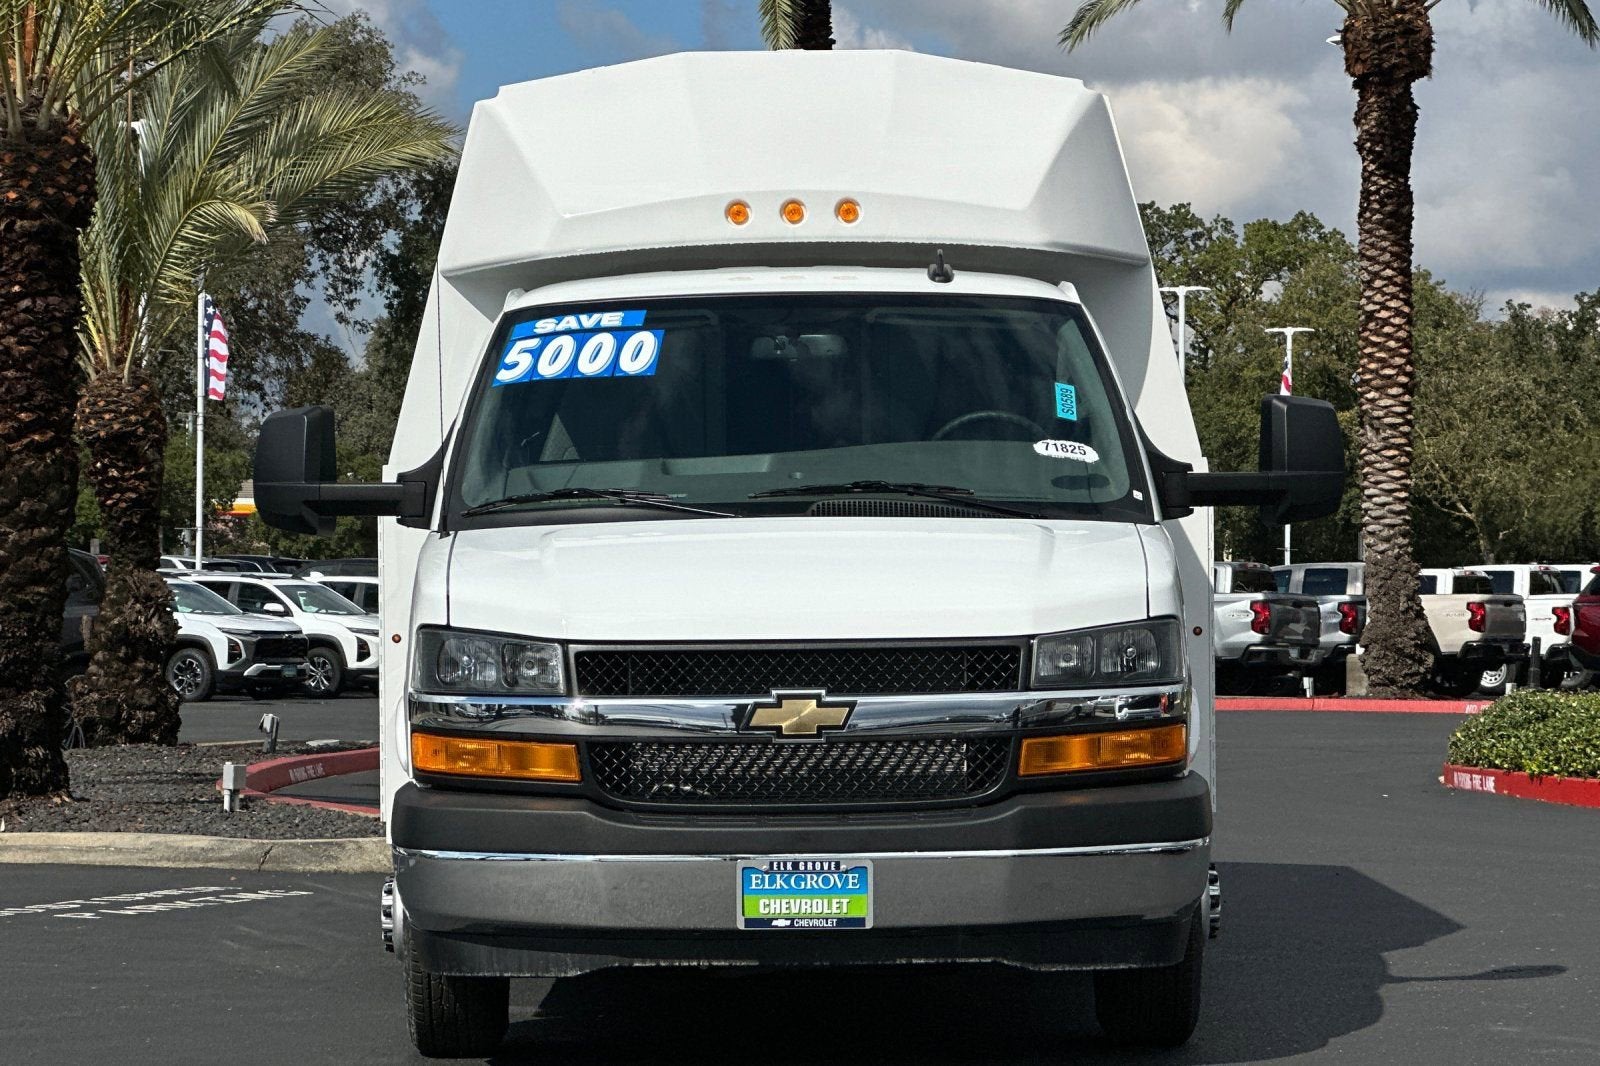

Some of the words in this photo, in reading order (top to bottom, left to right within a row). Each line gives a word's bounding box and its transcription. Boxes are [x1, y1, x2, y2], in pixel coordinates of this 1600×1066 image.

[533, 312, 624, 334] SAVE
[495, 330, 658, 382] 5000
[1042, 441, 1087, 456] 71825
[773, 861, 793, 871] ELK
[799, 861, 836, 871] GROVE
[759, 898, 851, 915] CHEVROLET
[794, 918, 837, 927] CHEVROLET
